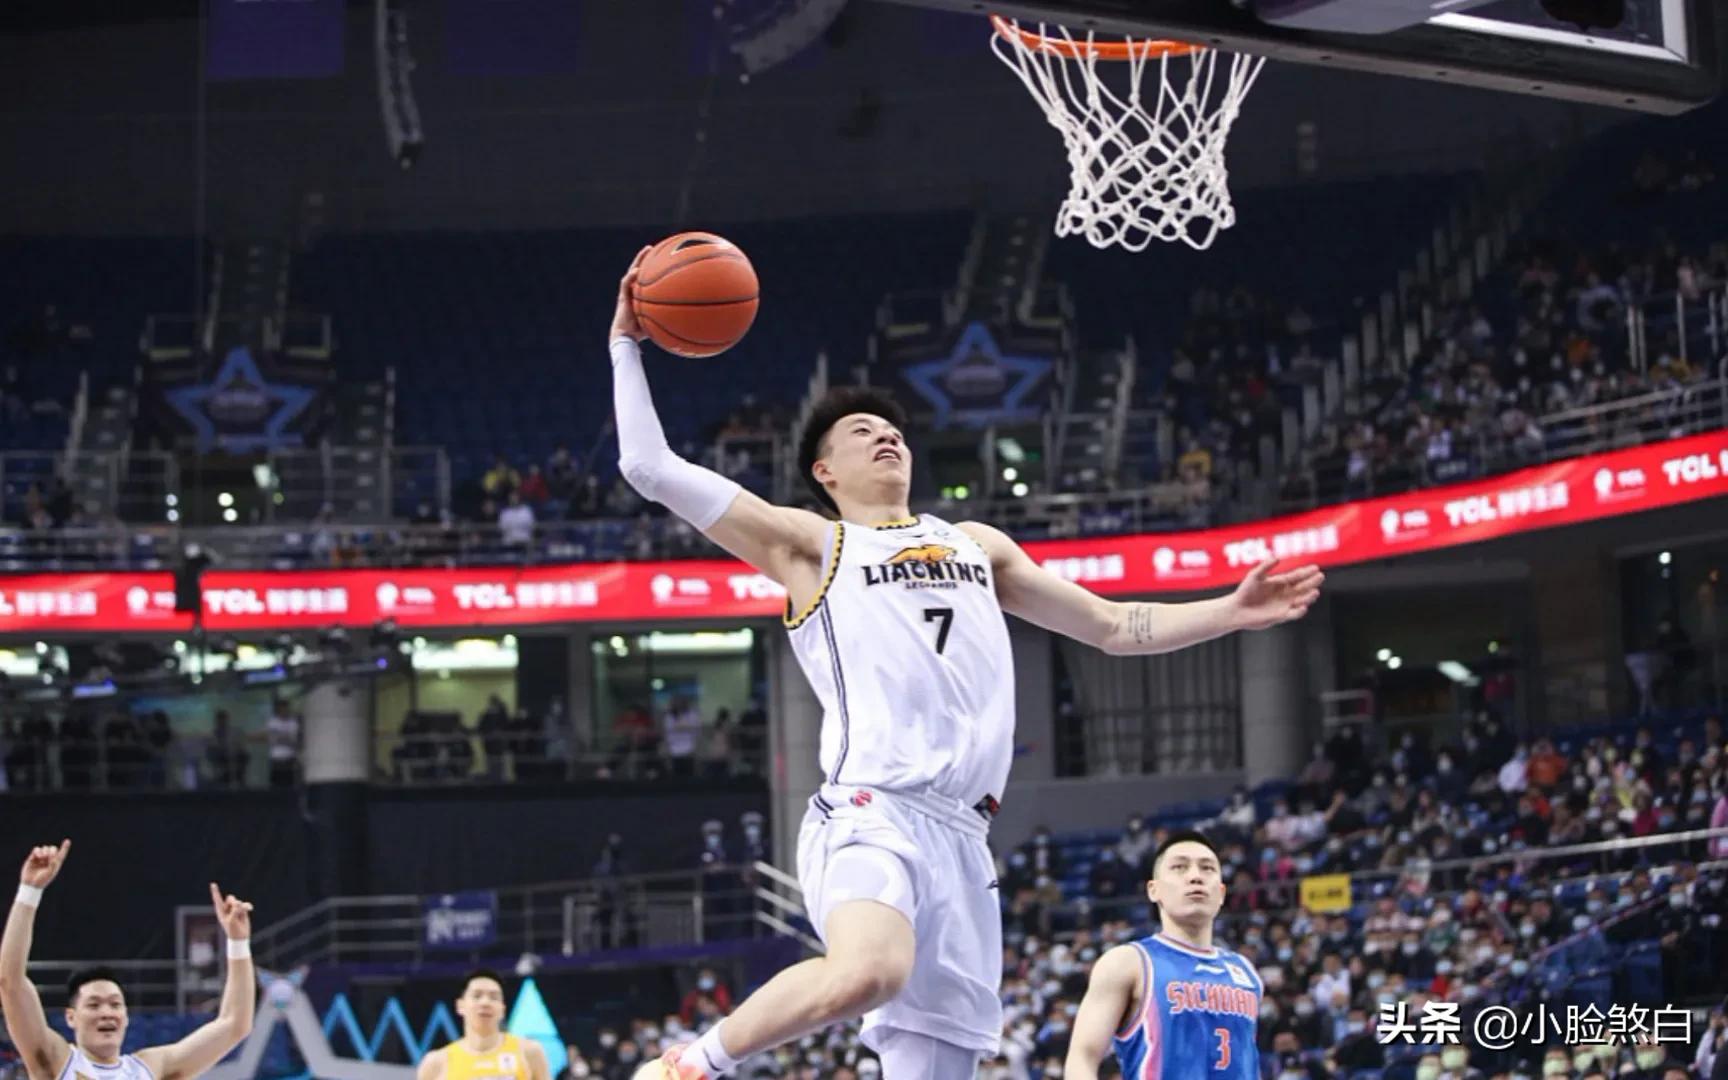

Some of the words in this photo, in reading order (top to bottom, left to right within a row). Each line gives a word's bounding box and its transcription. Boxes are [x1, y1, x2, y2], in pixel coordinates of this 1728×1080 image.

[1662, 453, 1717, 486] TCL
[1445, 497, 1496, 525] TCL
[1224, 538, 1273, 567] TCL
[861, 560, 988, 587] LIAONING
[204, 590, 264, 613] TCL
[454, 585, 513, 608] TCL
[923, 608, 954, 655] 7
[1166, 981, 1258, 1022] SICHUAN
[1213, 1028, 1231, 1070] 3
